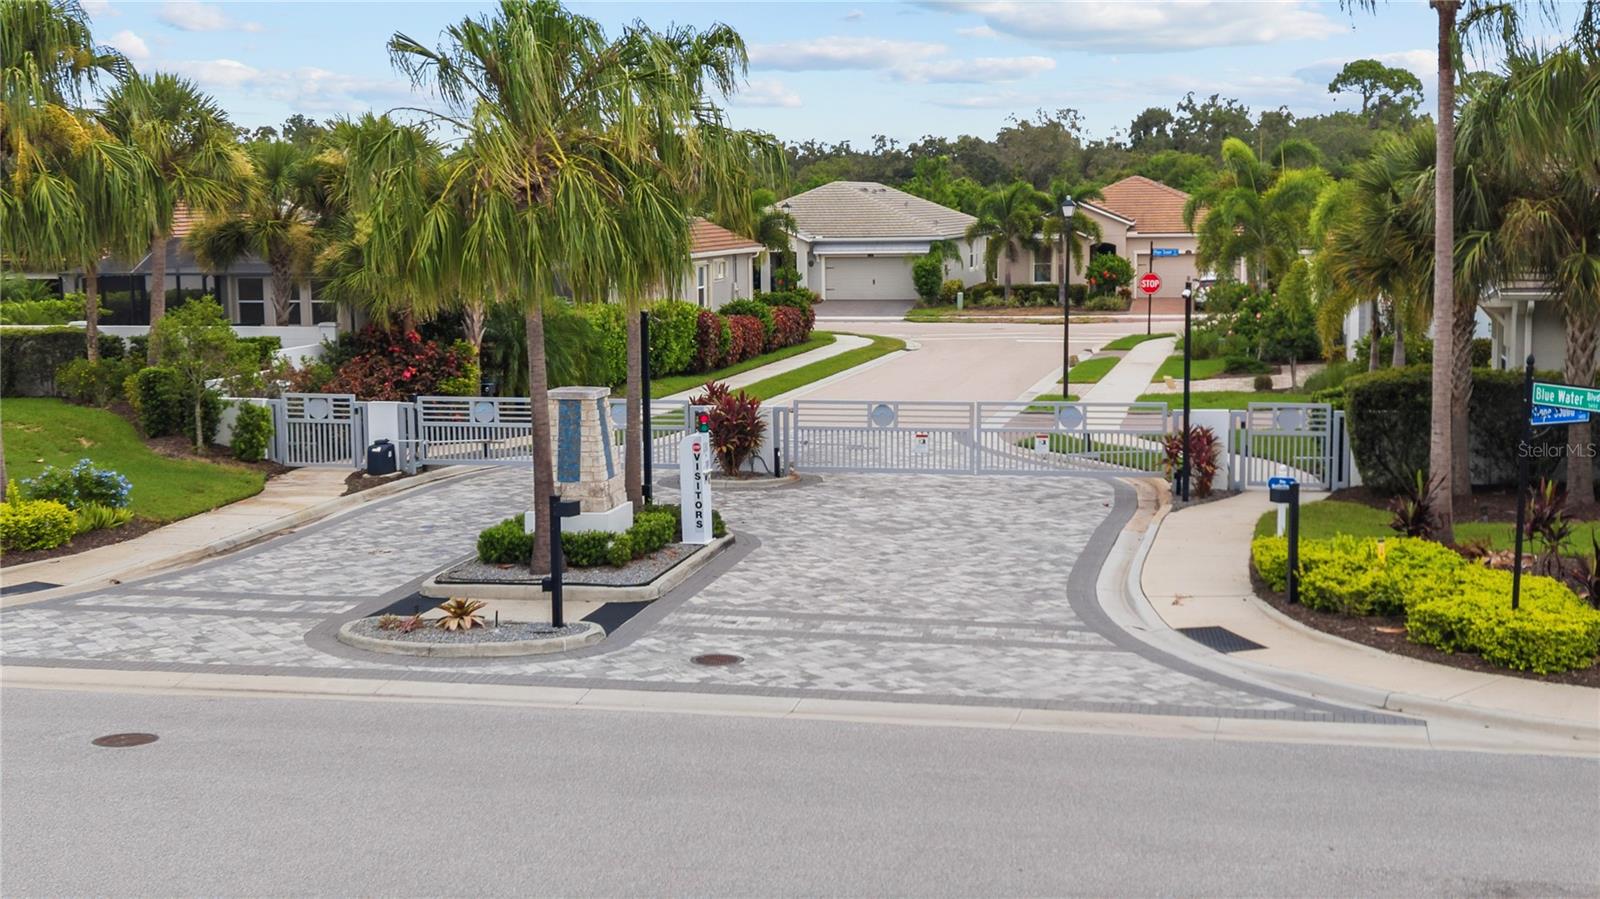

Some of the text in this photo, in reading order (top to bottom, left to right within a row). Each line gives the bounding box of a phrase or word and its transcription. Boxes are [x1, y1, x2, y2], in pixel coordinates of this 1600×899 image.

[1141, 280, 1160, 288] STOP
[1535, 387, 1555, 401] Blue
[1558, 390, 1584, 405] Water
[694, 454, 703, 528] VISITORS
